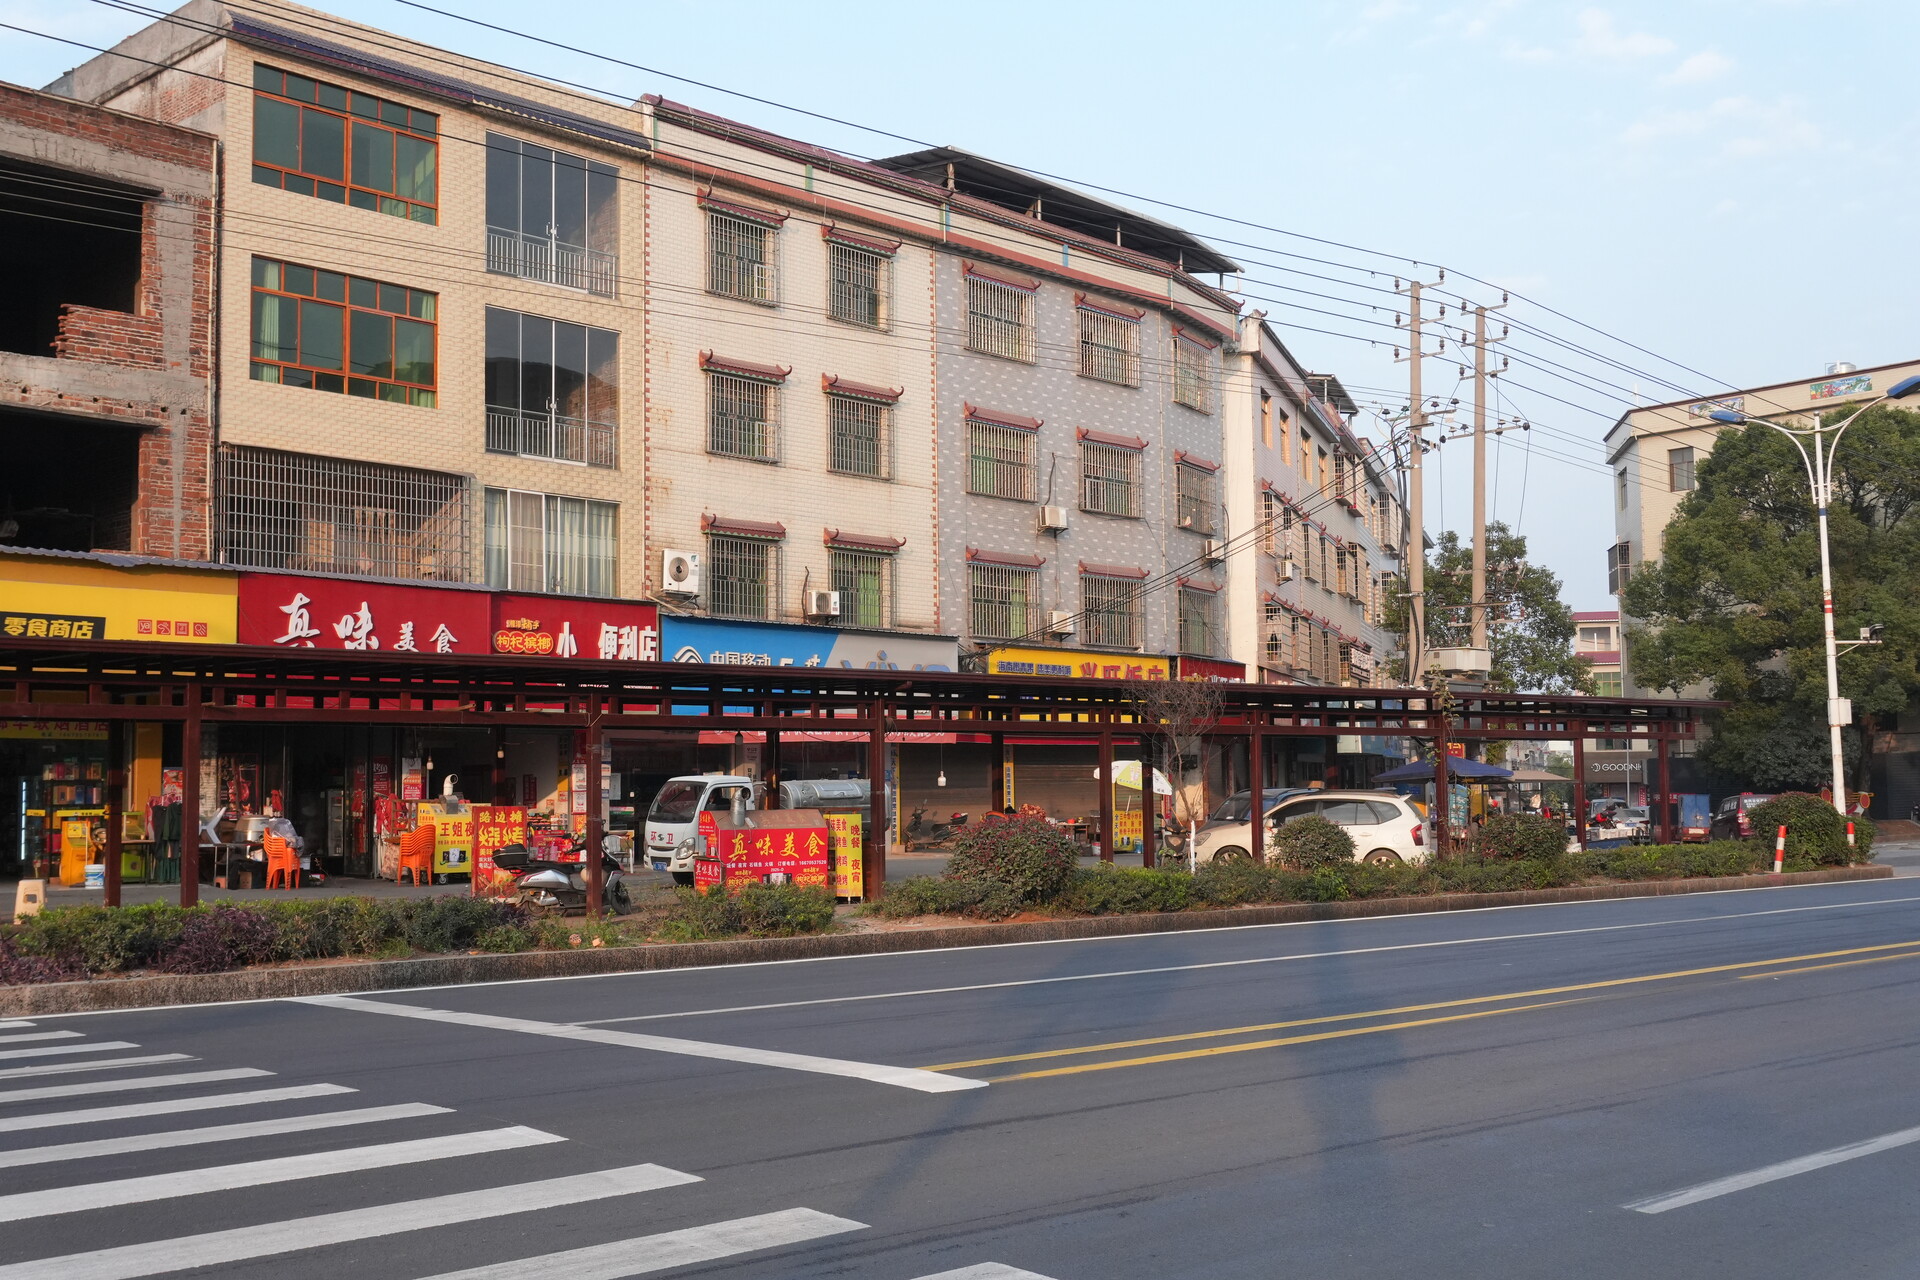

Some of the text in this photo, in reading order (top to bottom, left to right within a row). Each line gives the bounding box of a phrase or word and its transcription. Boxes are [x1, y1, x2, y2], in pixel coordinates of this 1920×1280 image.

[4, 616, 94, 639] 零食商店
[496, 634, 552, 651] 枸杞槟榔
[598, 622, 657, 661] 便利店
[1602, 763, 1642, 771] GOODNI
[479, 810, 523, 824] 路边摊
[479, 826, 524, 847] 烧烤
[727, 832, 825, 861] 真味美食
[850, 824, 860, 848] 晚餐
[851, 859, 861, 883] 夜宵
